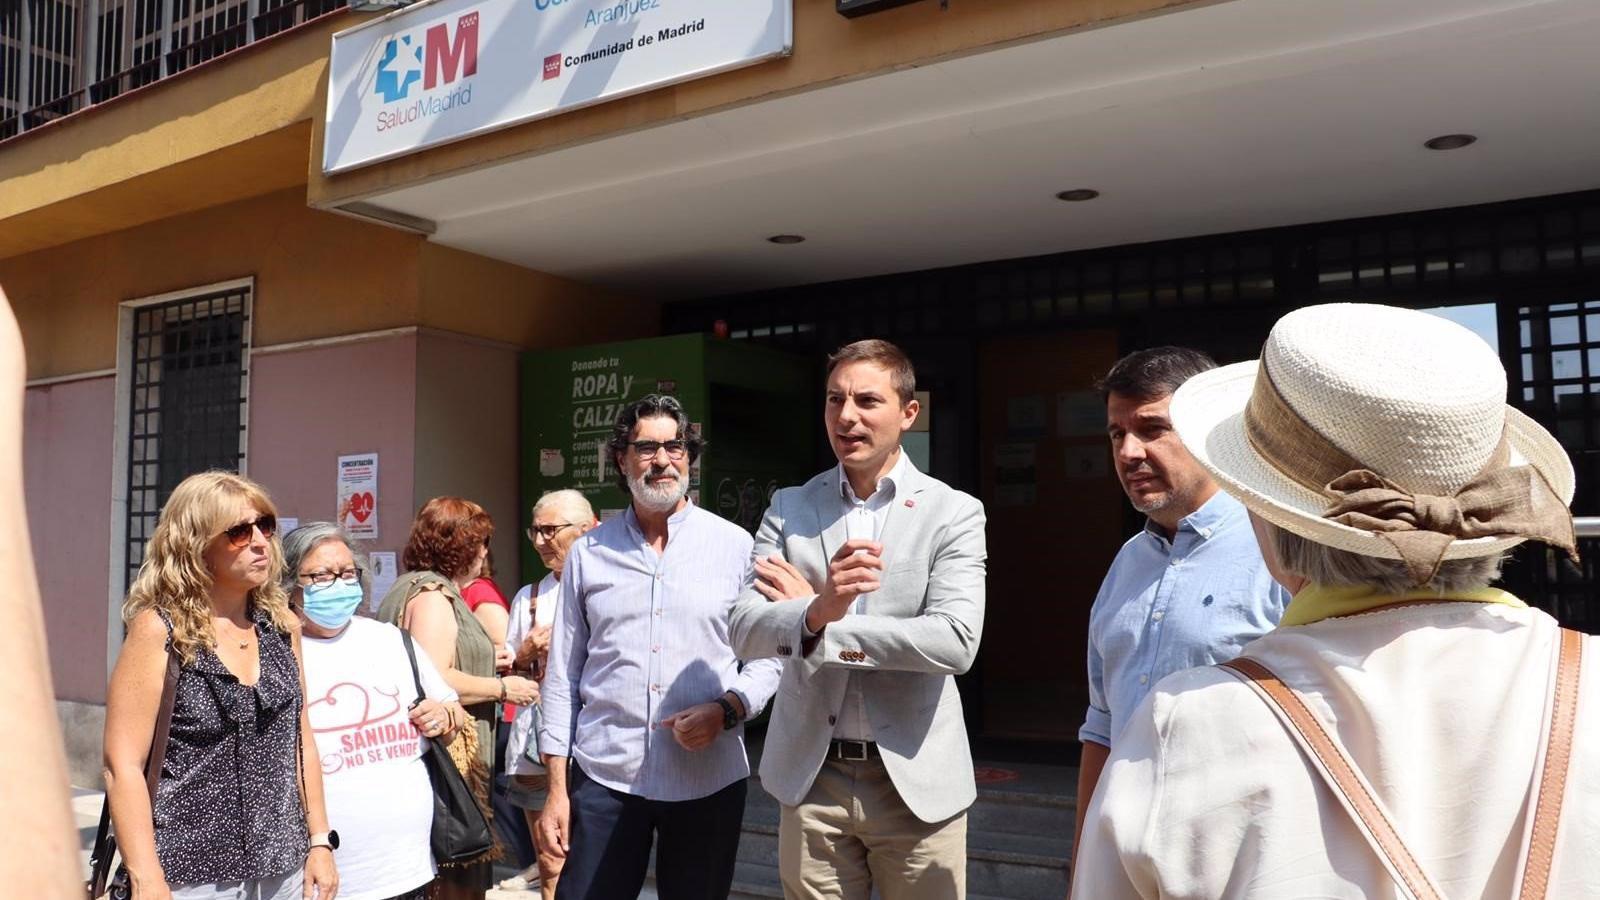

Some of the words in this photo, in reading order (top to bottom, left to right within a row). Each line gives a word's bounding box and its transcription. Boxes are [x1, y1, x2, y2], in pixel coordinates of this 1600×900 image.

[584, 0, 660, 28] Aranjuez
[564, 38, 634, 68] Comunidad
[637, 34, 654, 48] de
[657, 18, 706, 42] Madrid
[376, 82, 473, 132] SaludMadrid
[572, 372, 618, 398] ROPA
[621, 375, 634, 399] y
[573, 403, 625, 429] CALZA
[340, 721, 420, 753] SANIDAD
[345, 753, 365, 769] NO
[367, 747, 383, 763] SE
[385, 741, 419, 760] VENDE
